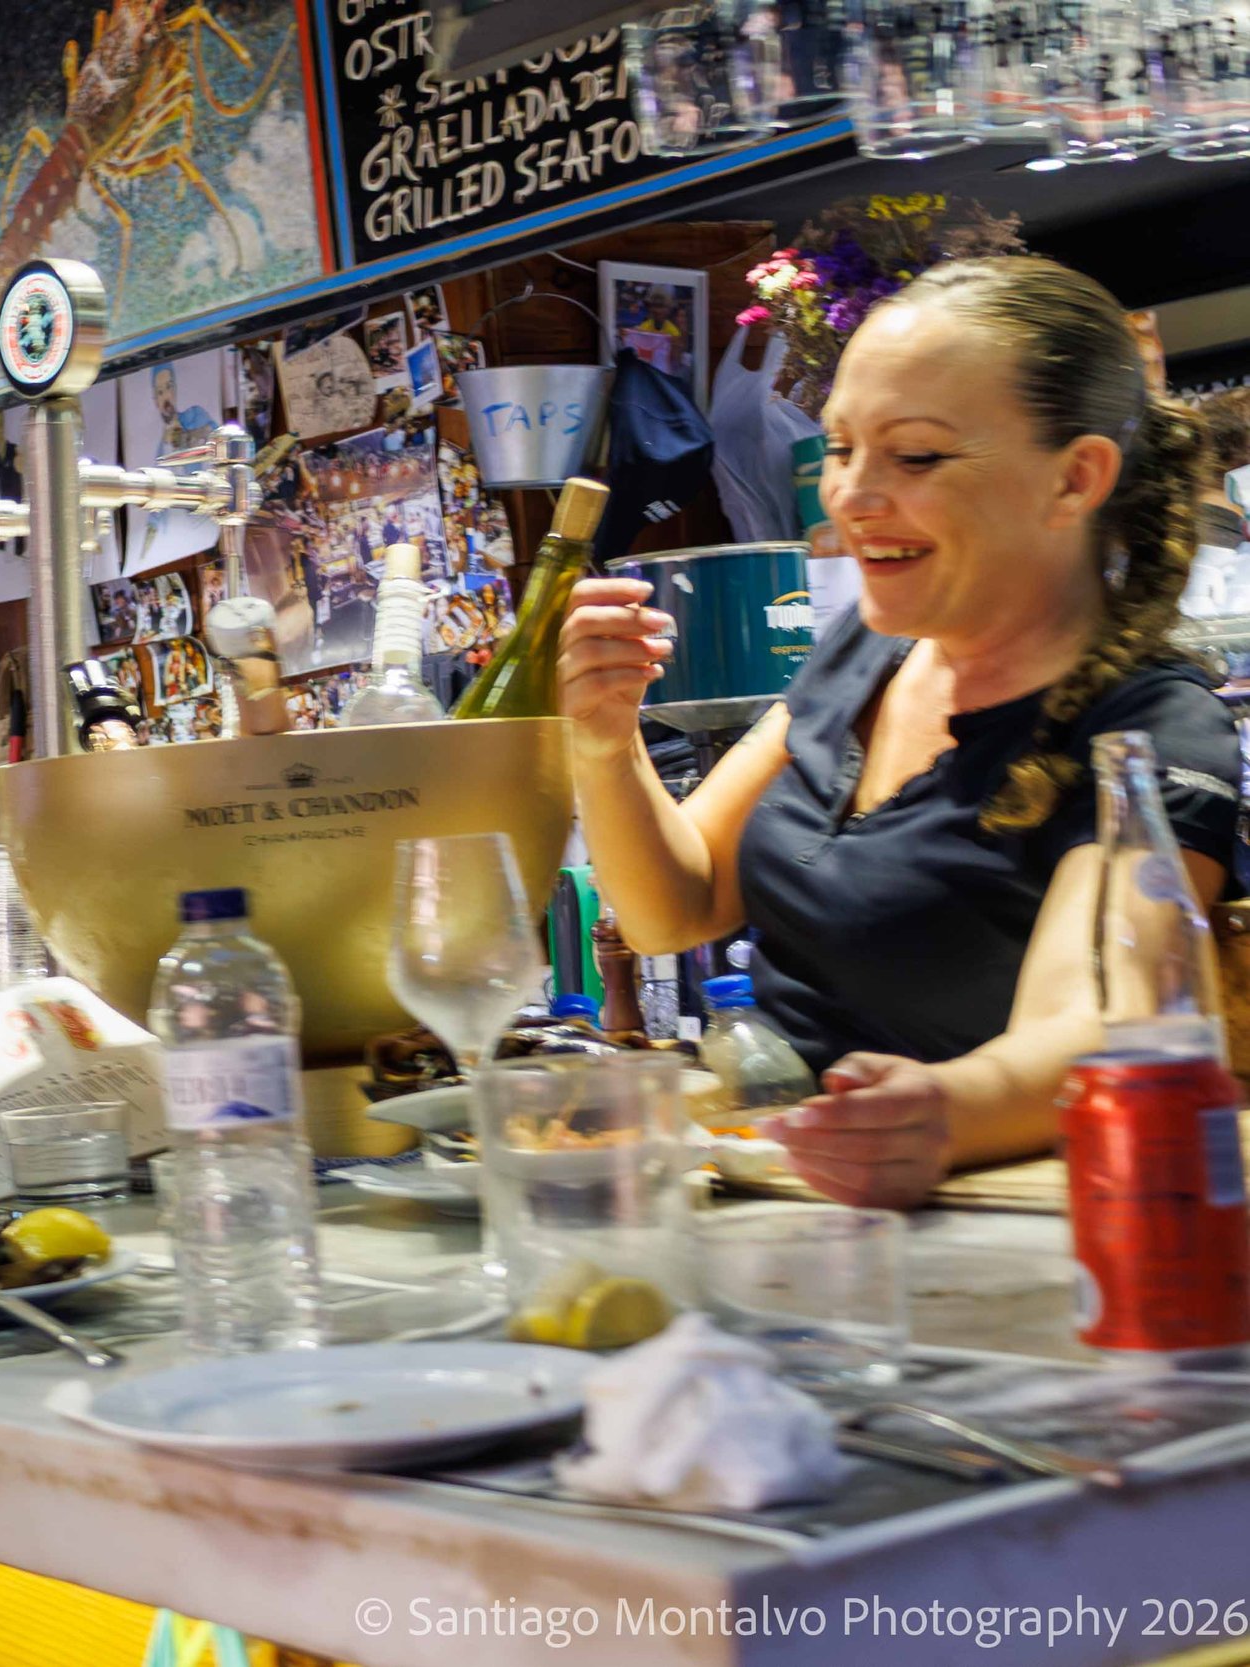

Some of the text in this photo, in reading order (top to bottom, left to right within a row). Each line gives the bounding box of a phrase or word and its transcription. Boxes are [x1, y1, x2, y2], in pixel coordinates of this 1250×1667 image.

[344, 10, 435, 80] OSTR
[360, 77, 571, 191] GRAELLADA
[365, 117, 642, 242] GRILLED SEAFO
[480, 400, 586, 438] TAPS
[260, 800, 285, 822] &
[287, 787, 421, 818] CHANDON
